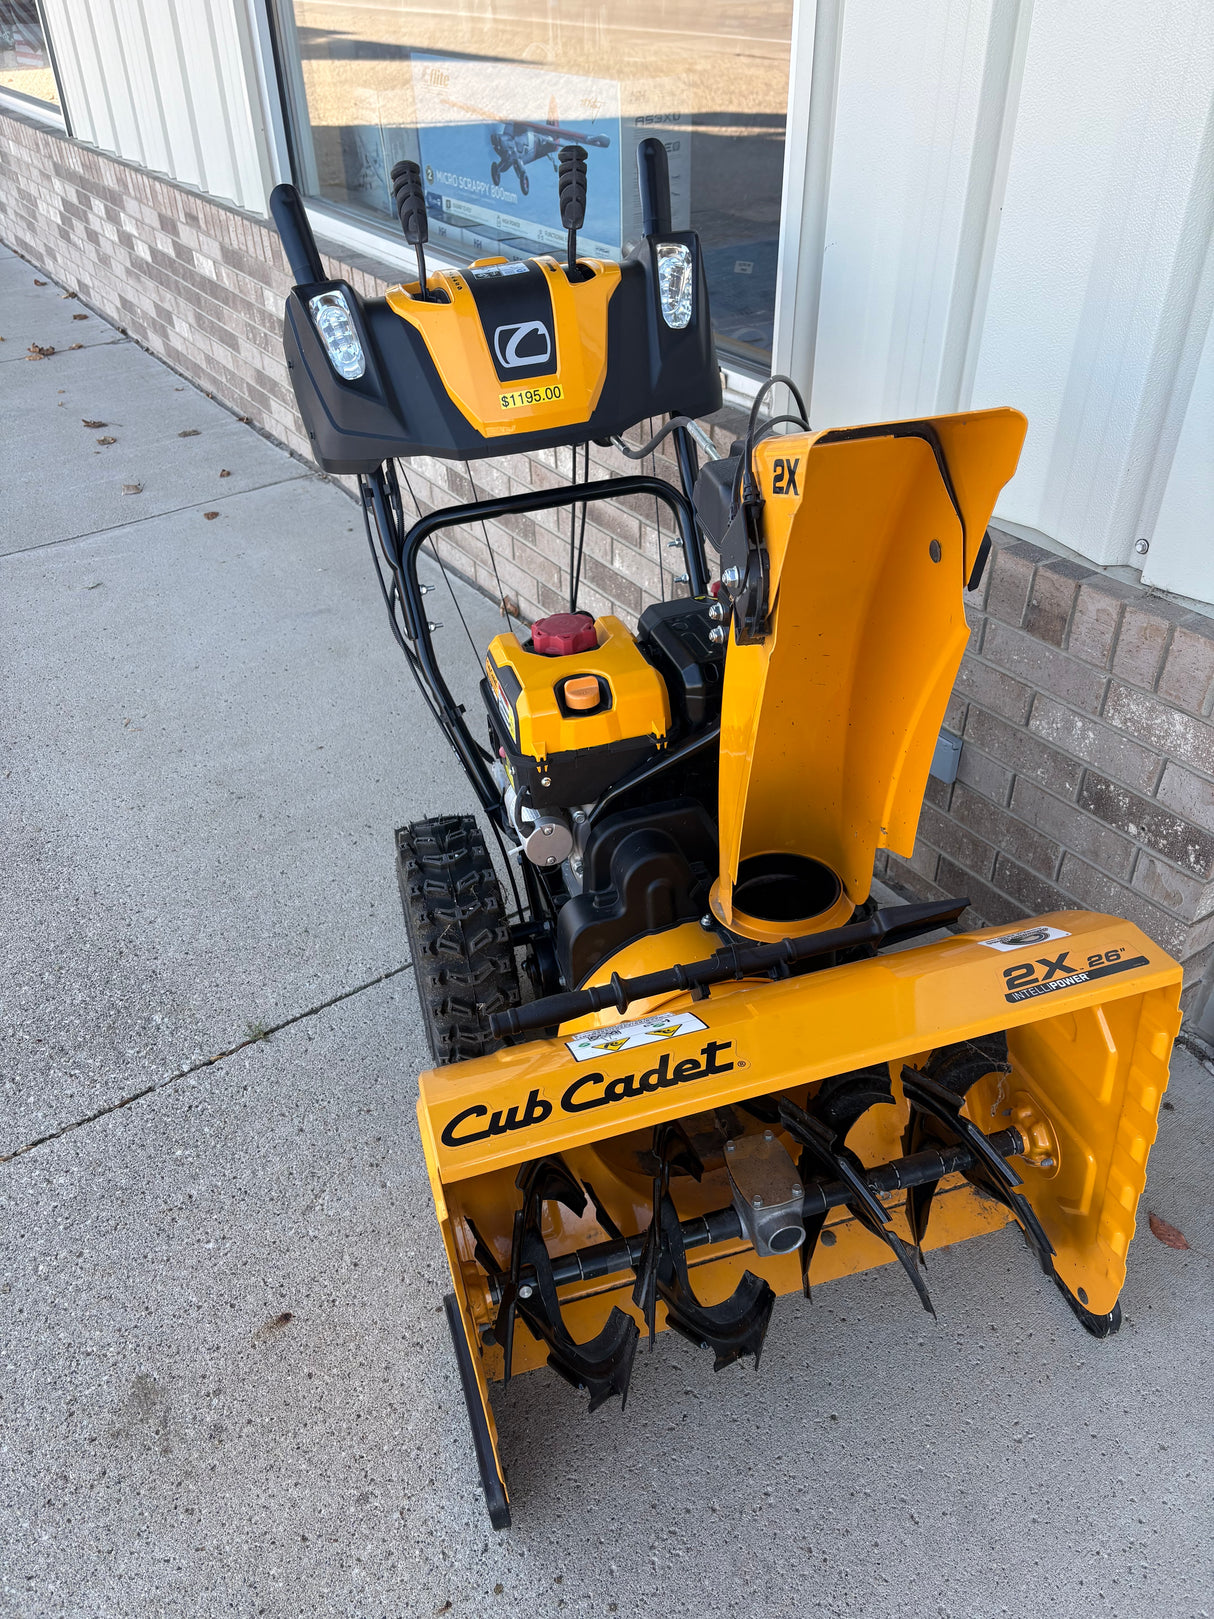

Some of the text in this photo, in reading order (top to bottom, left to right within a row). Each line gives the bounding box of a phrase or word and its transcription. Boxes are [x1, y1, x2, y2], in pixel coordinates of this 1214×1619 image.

[436, 170, 457, 188] MICRO
[458, 177, 490, 197] SCRAPPY
[491, 184, 518, 205] 800mm
[501, 386, 561, 408] $1195.00
[772, 458, 800, 496] 2X
[1003, 948, 1126, 991] 2X 26"
[1011, 973, 1087, 1001] INTELLIPOWER
[441, 1040, 735, 1147] Cub Cadet
